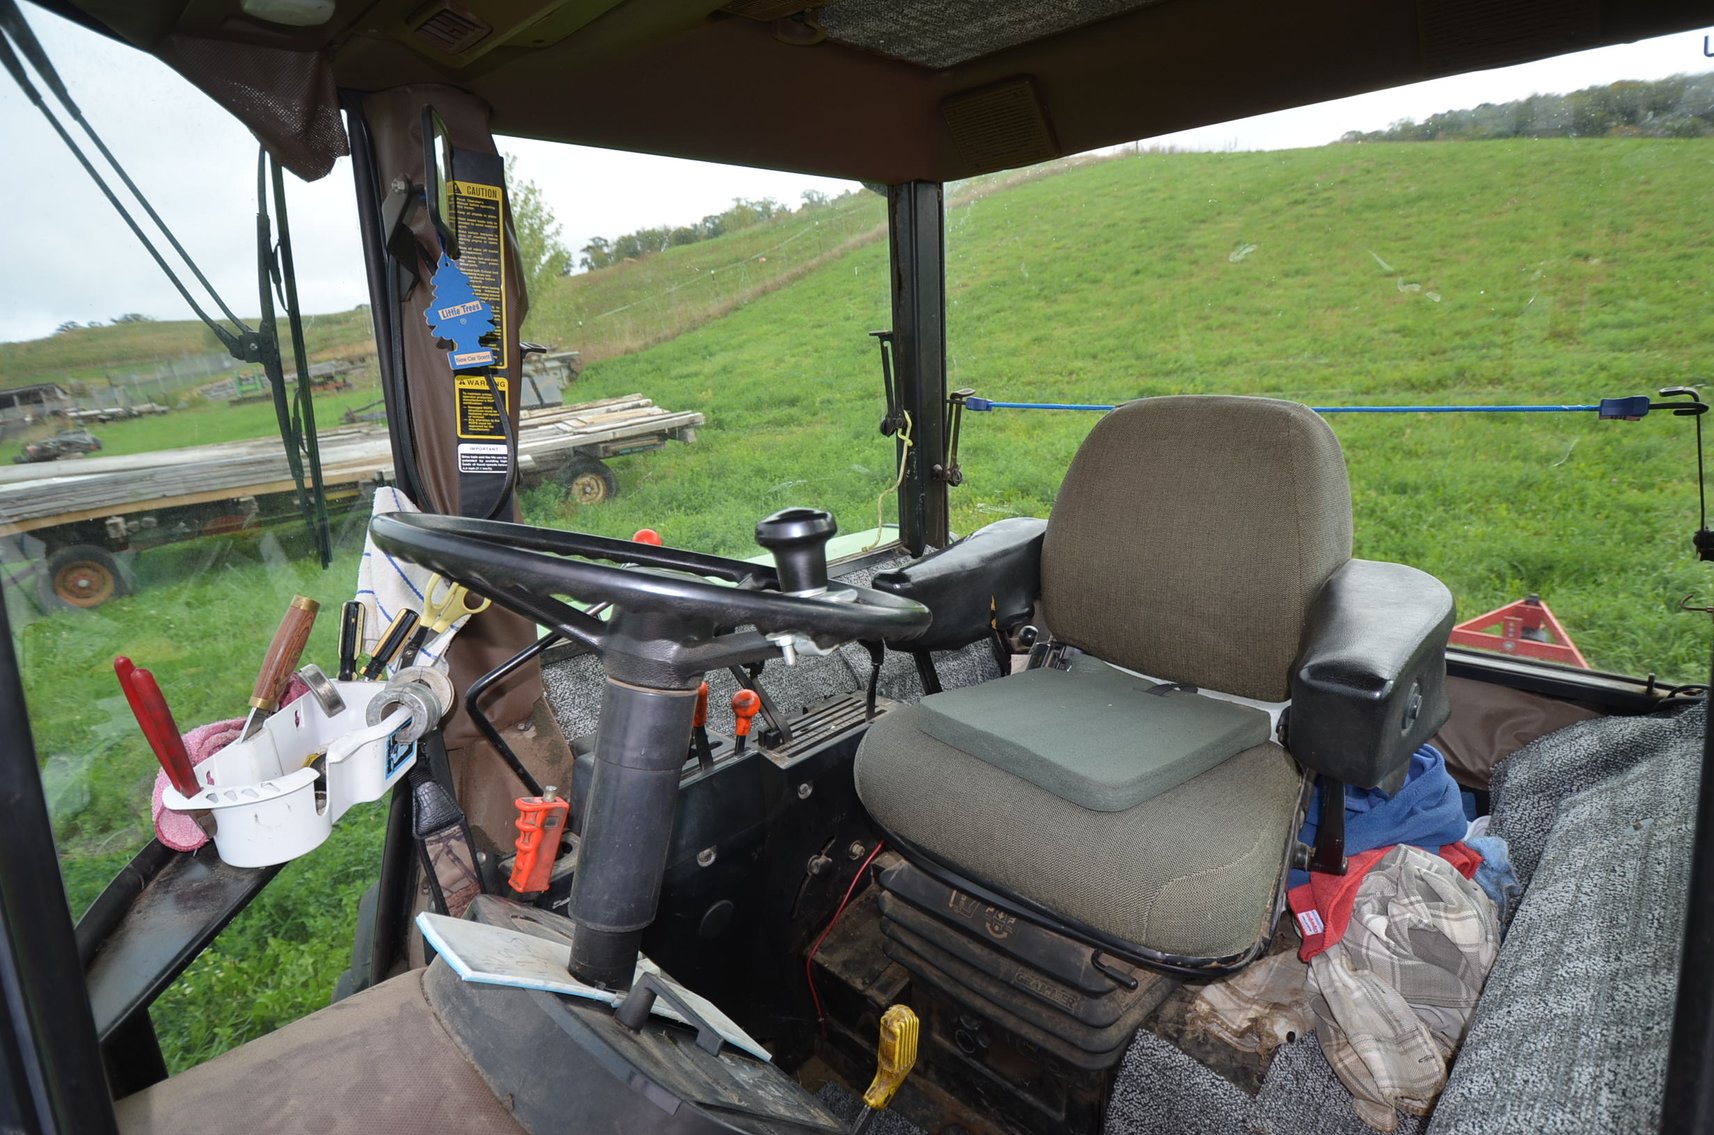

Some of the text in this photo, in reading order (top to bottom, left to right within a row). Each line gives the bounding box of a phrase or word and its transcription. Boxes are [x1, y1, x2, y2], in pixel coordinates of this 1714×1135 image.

[467, 185, 497, 198] CAUTION
[441, 307, 461, 319] Little
[462, 303, 480, 314] Trees
[467, 380, 505, 388] WARNG
